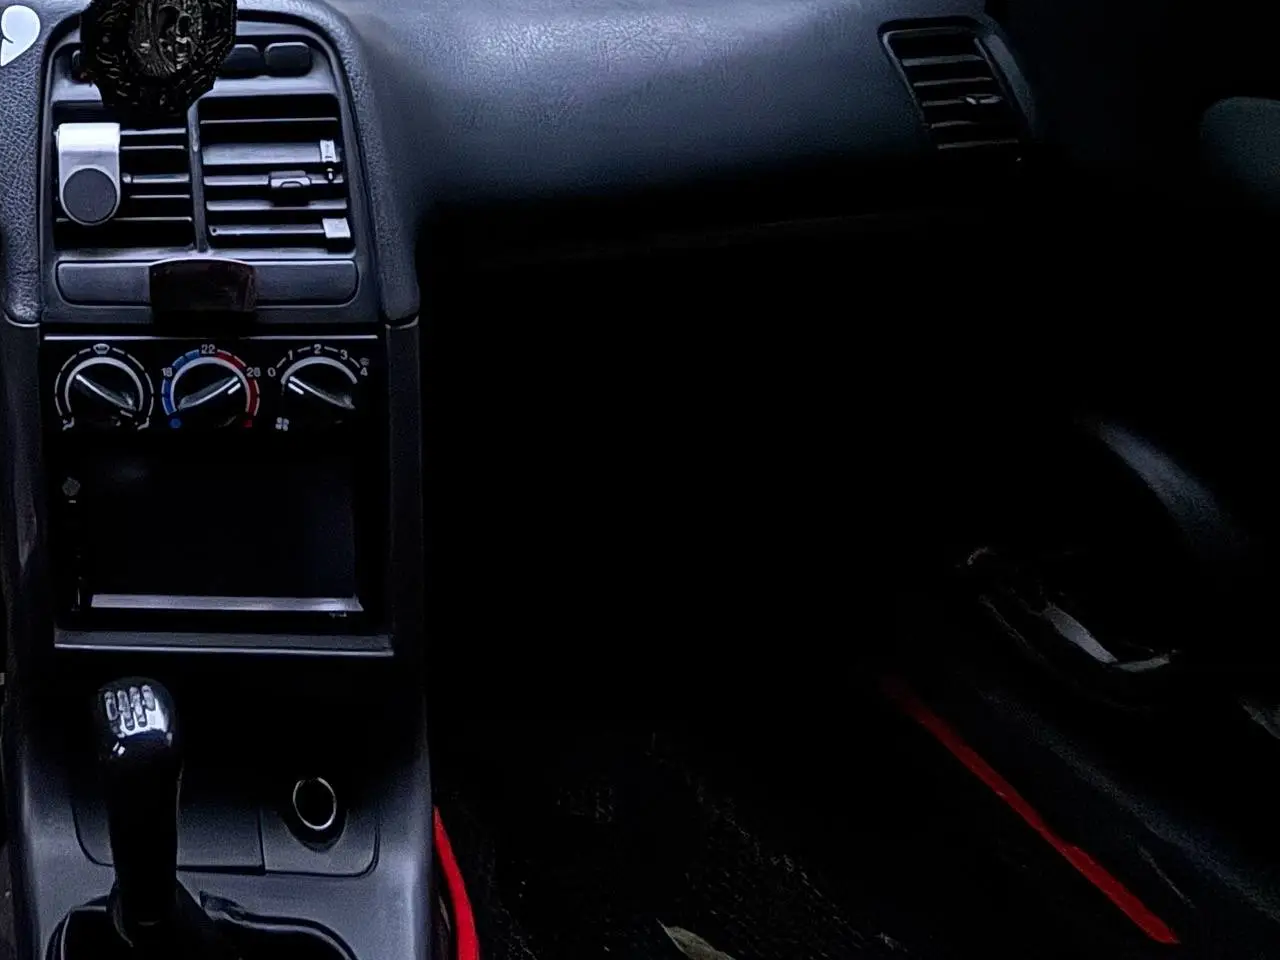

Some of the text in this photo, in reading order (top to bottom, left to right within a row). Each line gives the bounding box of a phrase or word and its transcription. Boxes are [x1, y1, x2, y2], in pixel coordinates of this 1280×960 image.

[201, 343, 216, 355] 22
[313, 343, 322, 355] 2
[340, 349, 348, 361] 3
[360, 366, 368, 377] 4
